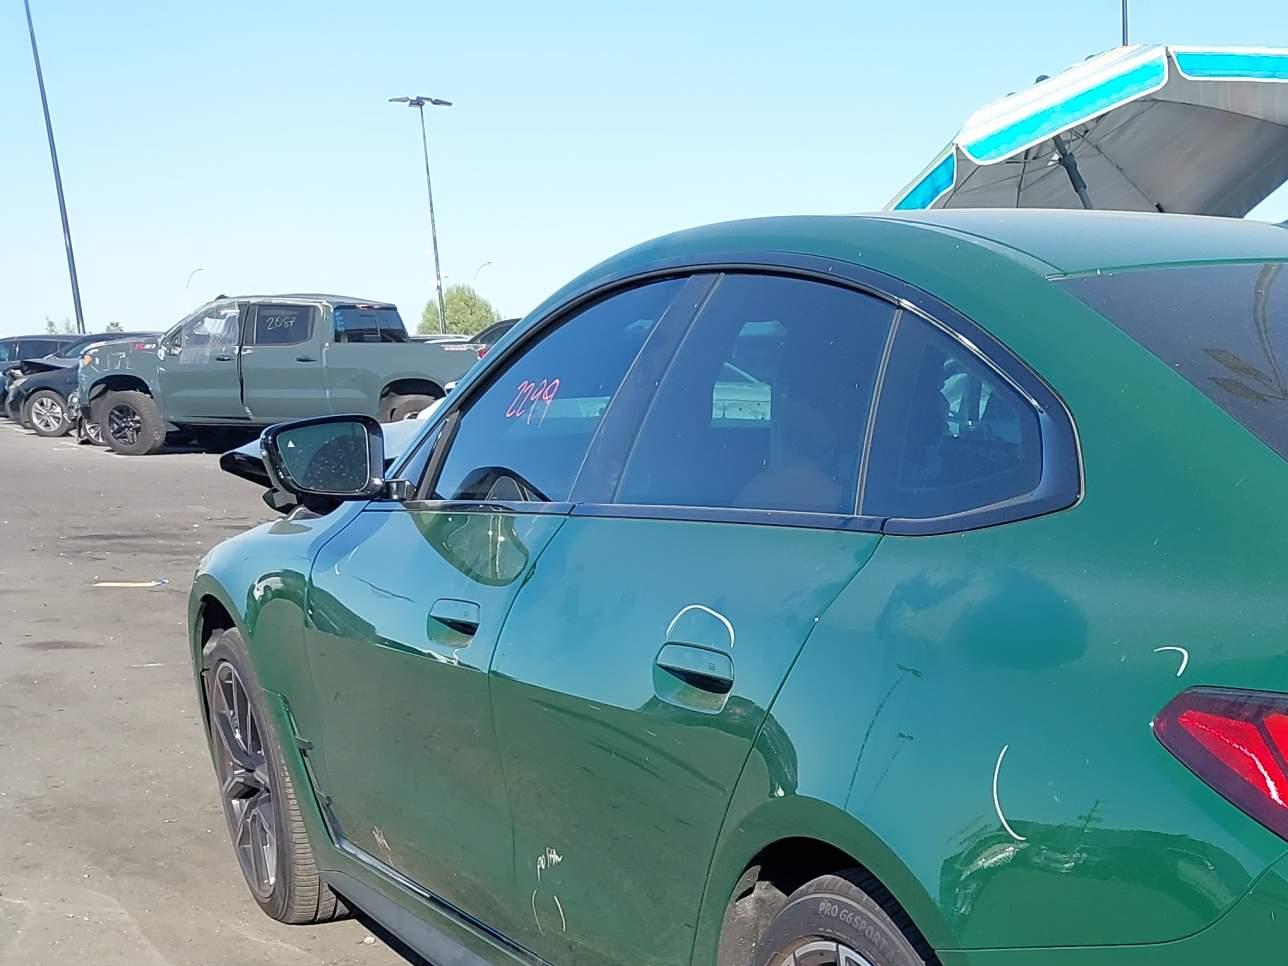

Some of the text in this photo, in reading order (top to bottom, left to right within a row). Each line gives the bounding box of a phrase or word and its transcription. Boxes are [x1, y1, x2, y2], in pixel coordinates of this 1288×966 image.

[818, 902, 839, 917] PRO
[839, 909, 853, 924] G6
[852, 915, 888, 950] SPORT
